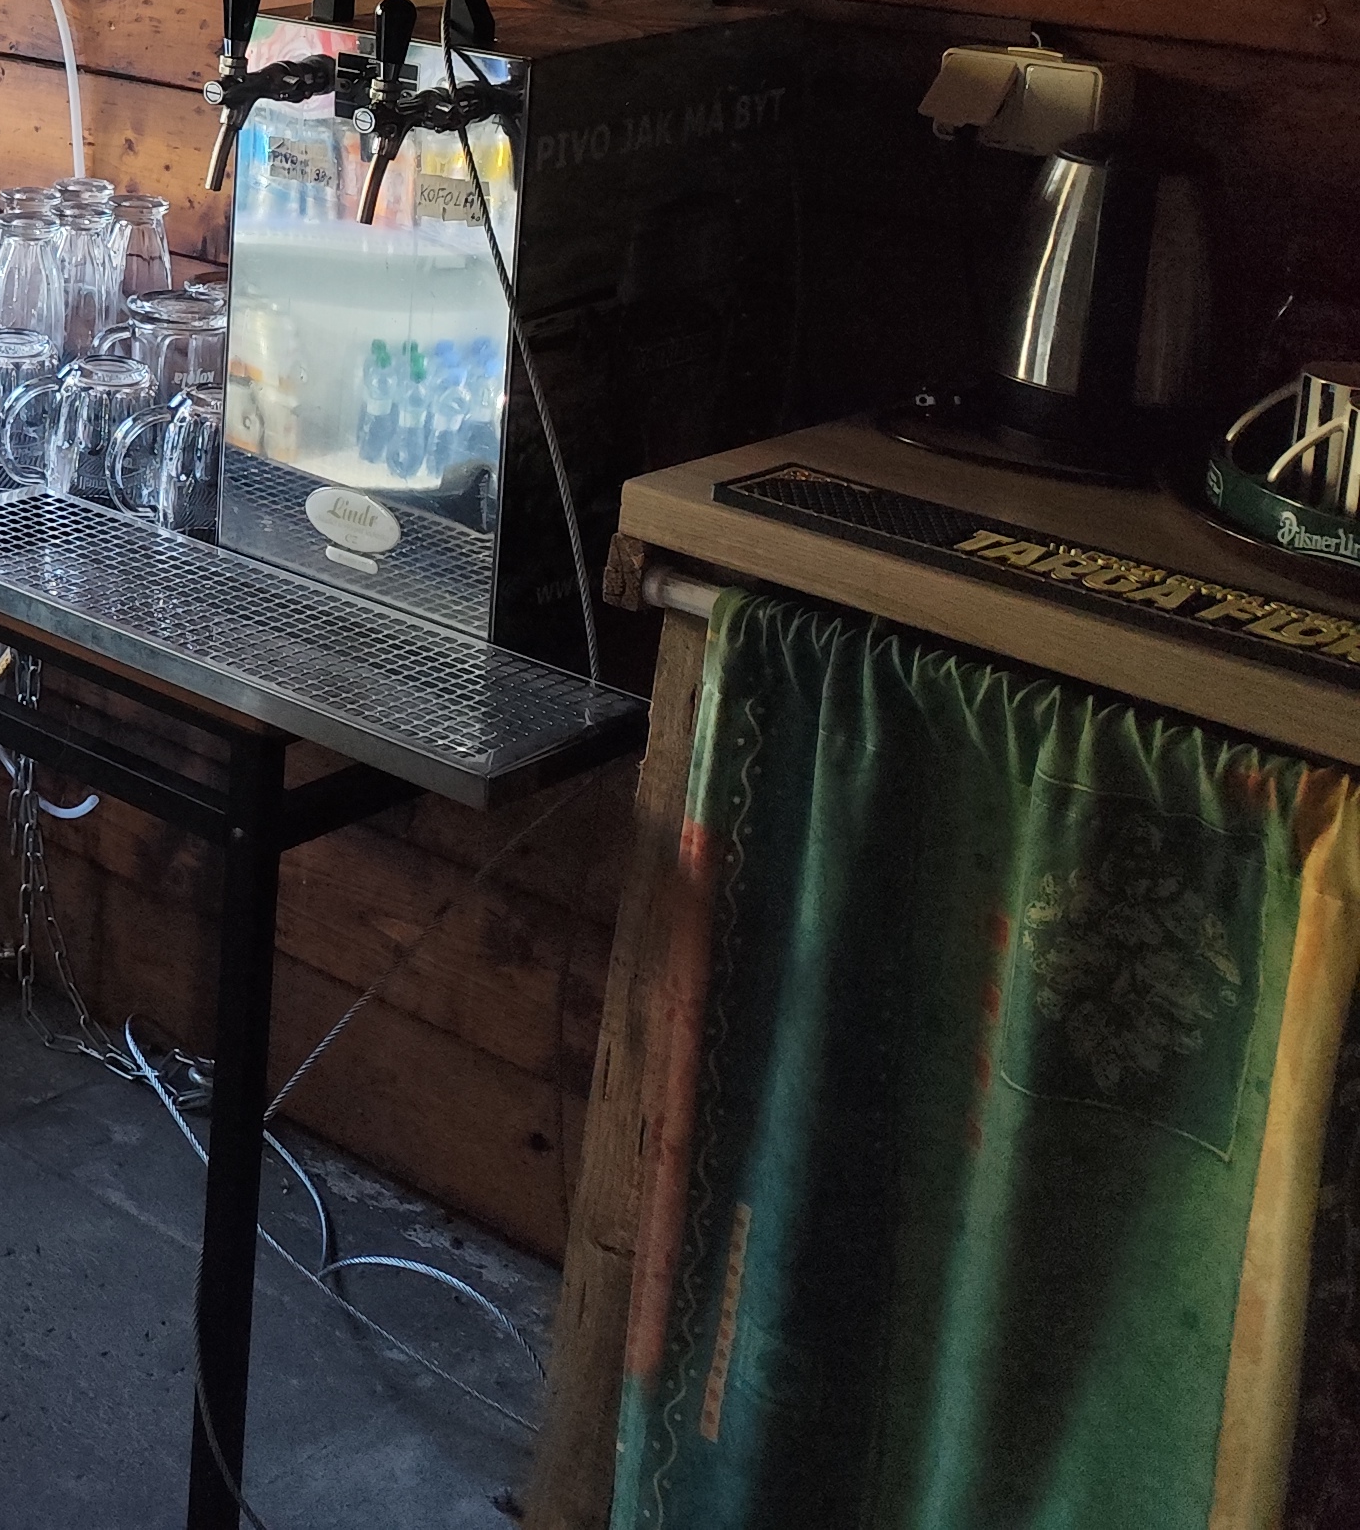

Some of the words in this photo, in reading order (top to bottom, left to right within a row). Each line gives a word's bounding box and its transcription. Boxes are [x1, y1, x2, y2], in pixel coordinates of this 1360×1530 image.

[418, 183, 475, 209] KOFOLA
[327, 496, 378, 528] Lindr
[953, 528, 1195, 610] TARGA
